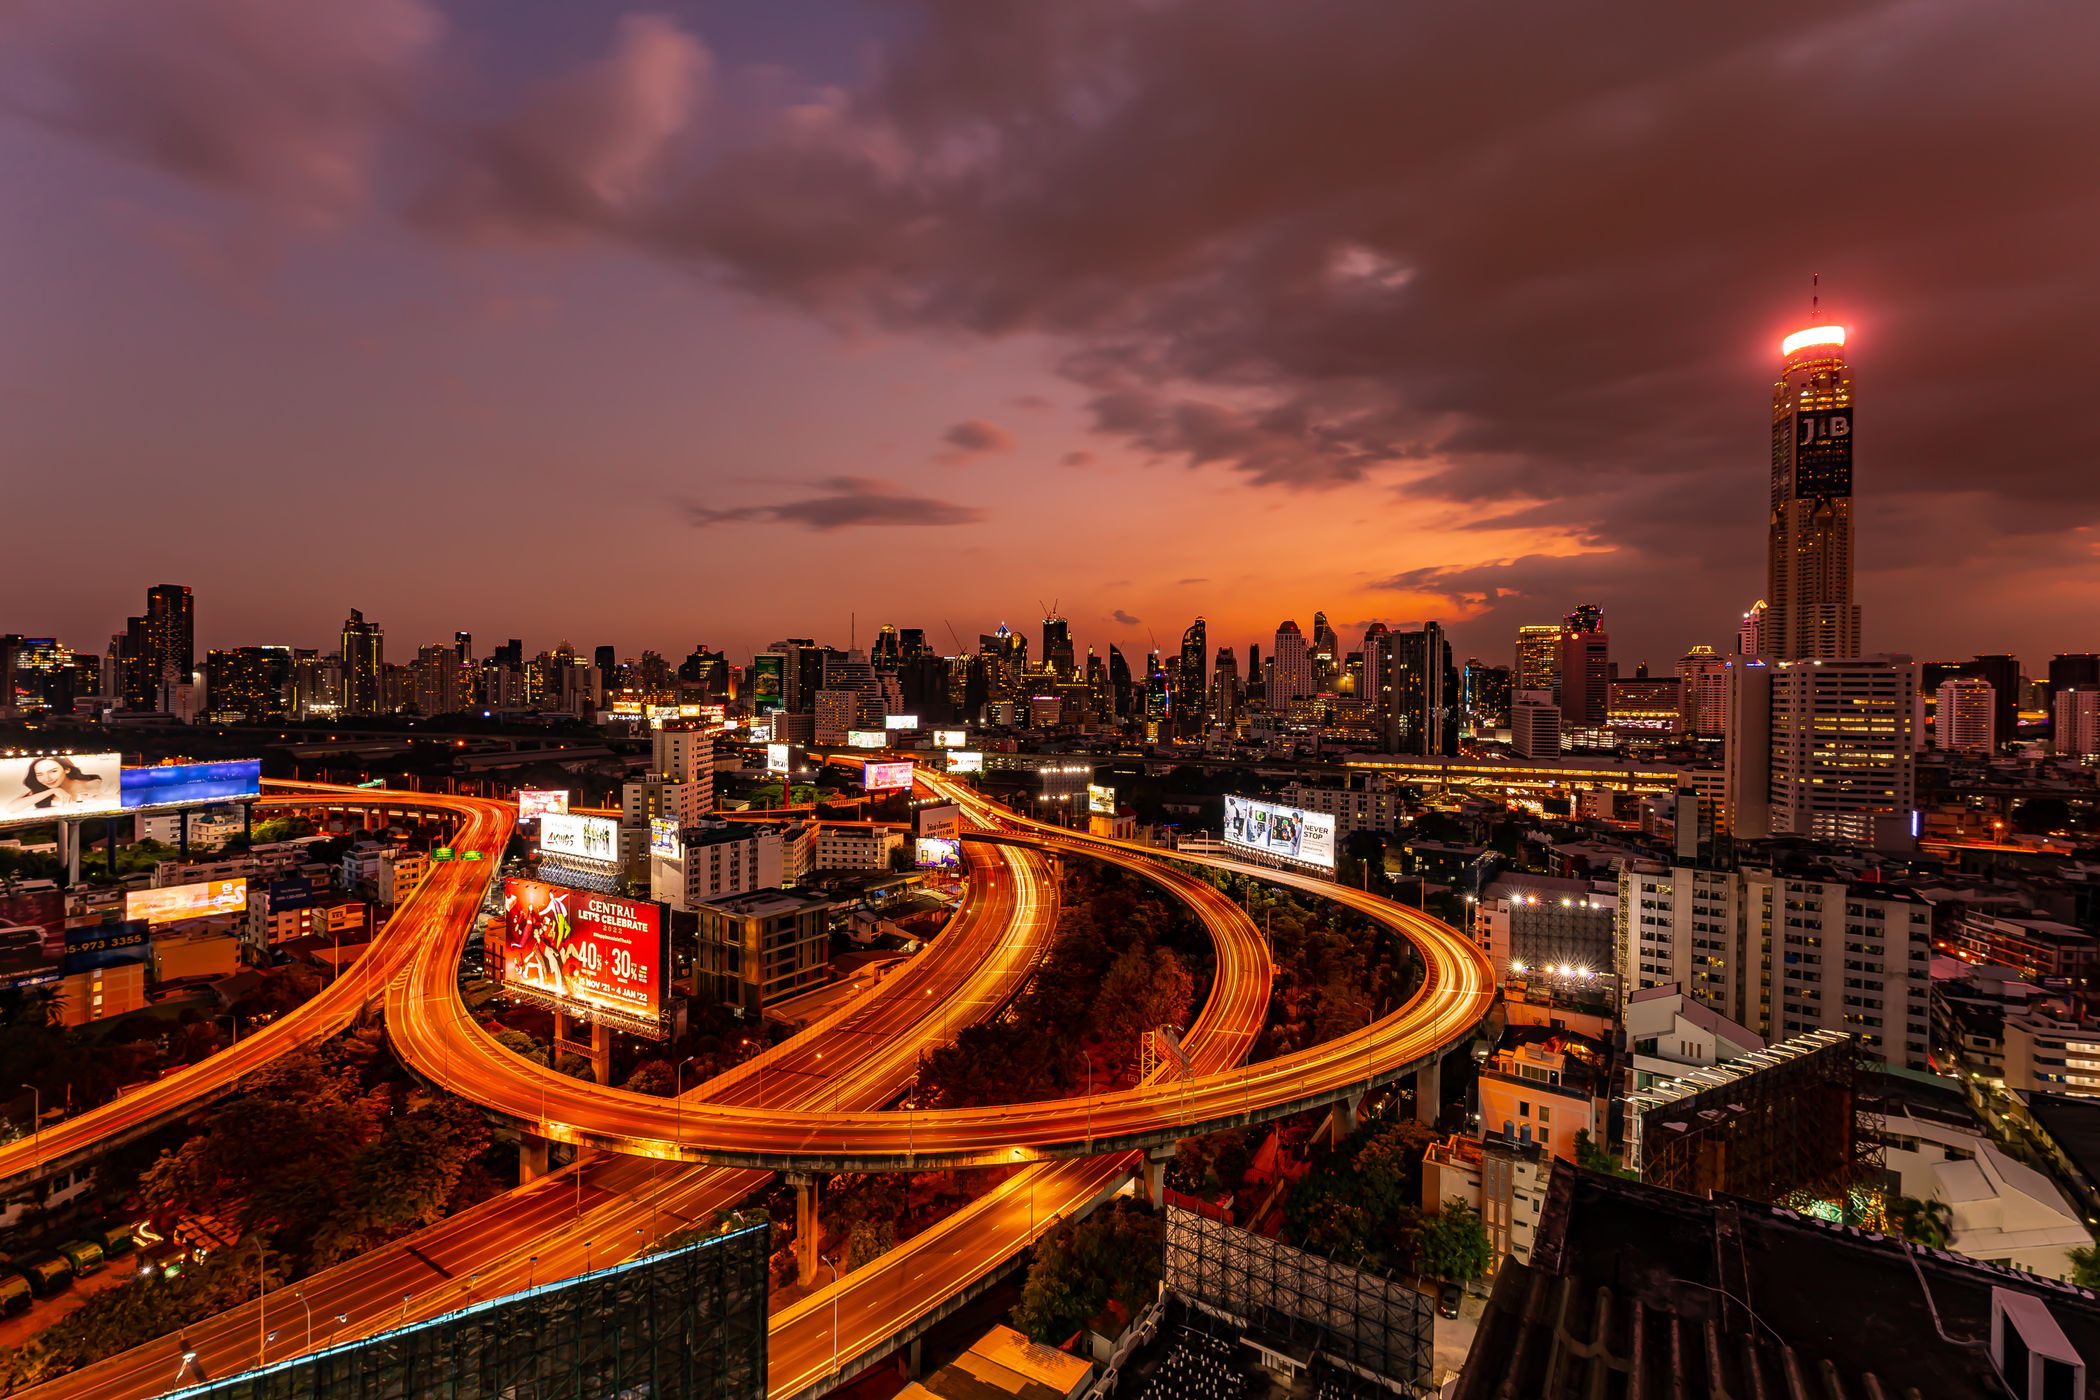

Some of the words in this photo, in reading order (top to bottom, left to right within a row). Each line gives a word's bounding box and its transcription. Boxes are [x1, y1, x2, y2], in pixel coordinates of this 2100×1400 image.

[1800, 416, 1850, 446] JIB
[1304, 825, 1329, 834] NEVER
[1304, 831, 1323, 840] STOP
[588, 900, 637, 919] CENTRAL
[578, 909, 600, 923] LET'S
[601, 914, 648, 932] CELEBRATE
[602, 925, 623, 934] 2022
[111, 935, 142, 947] 3355
[585, 978, 600, 989] NOV
[616, 986, 621, 994] 4
[622, 989, 636, 998] JAN
